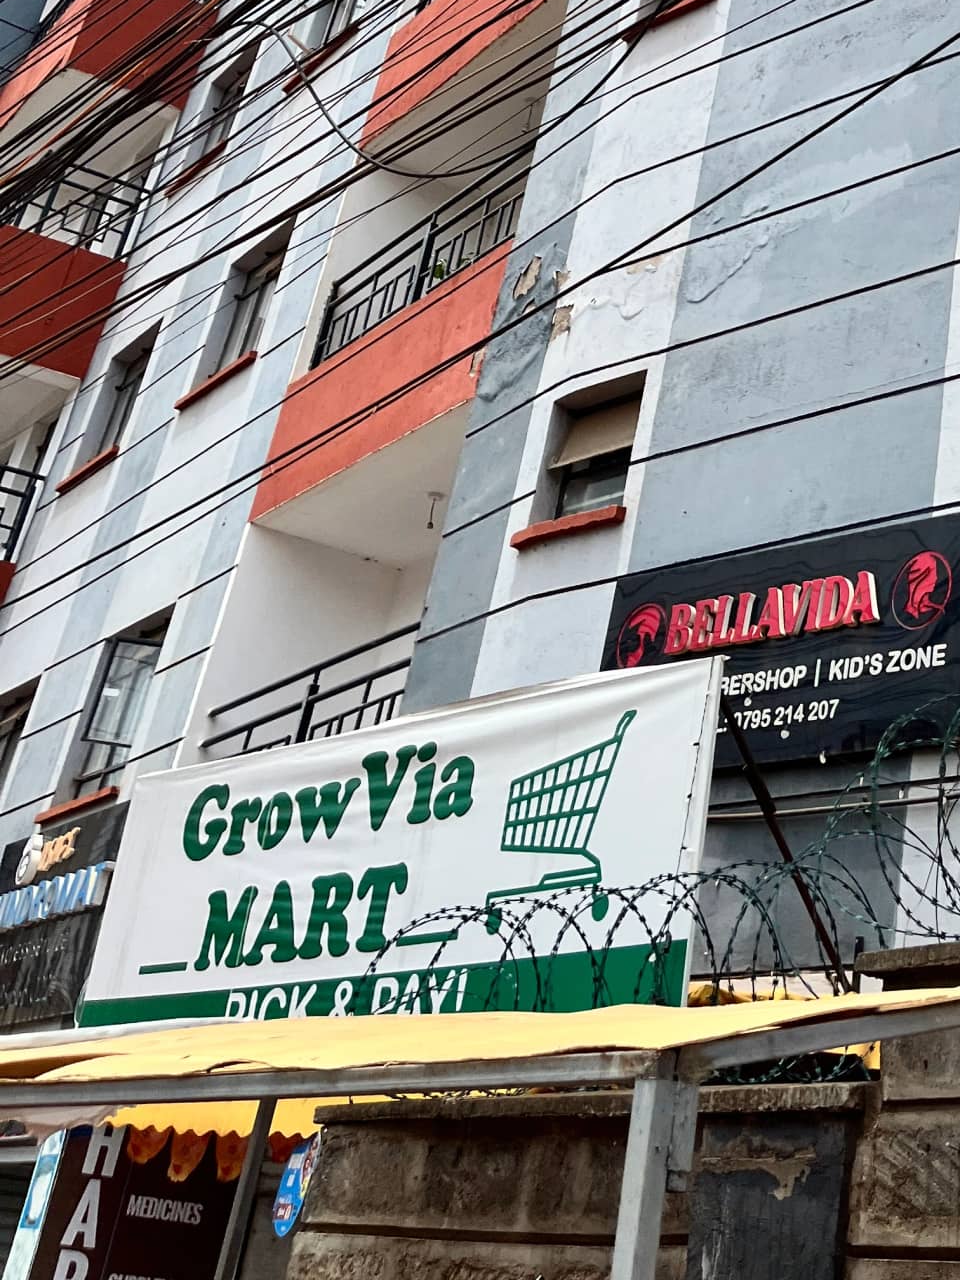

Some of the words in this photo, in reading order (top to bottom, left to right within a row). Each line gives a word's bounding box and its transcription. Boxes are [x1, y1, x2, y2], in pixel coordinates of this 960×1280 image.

[664, 570, 880, 656] BELLAVIDA
[828, 652, 884, 682] KID'S
[885, 643, 948, 673] ZONE
[773, 704, 805, 727] 214
[807, 698, 840, 721] 207
[183, 741, 476, 861] GrowVia
[194, 862, 409, 971] MART
[224, 983, 318, 1021] PICK
[126, 1194, 205, 1225] MEDICINES
